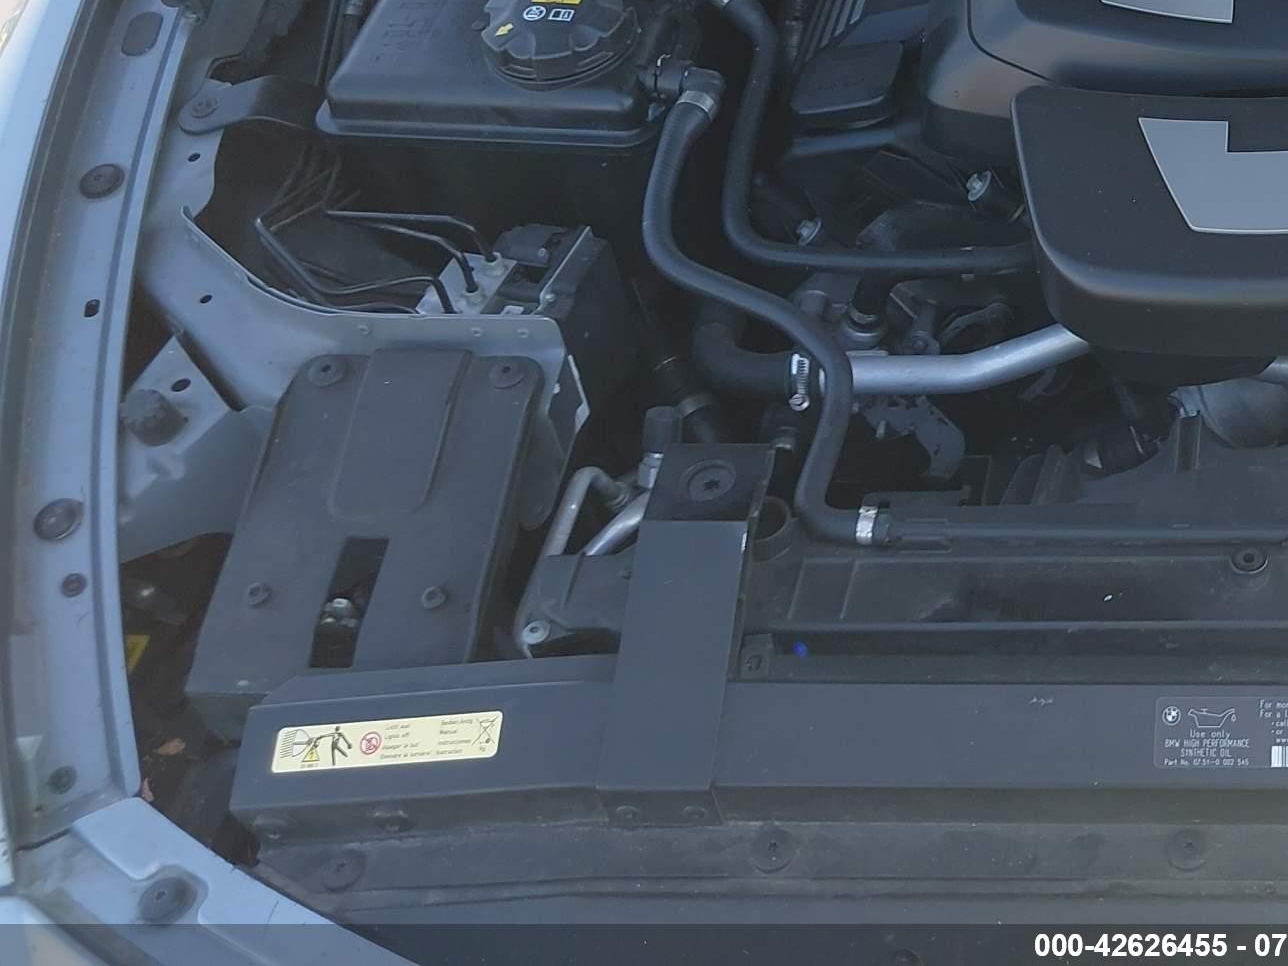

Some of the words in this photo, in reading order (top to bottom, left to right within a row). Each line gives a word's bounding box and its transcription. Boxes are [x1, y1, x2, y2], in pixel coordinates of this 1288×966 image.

[1259, 698, 1273, 709] For
[1259, 708, 1273, 718] For
[1190, 729, 1207, 738] Use
[1210, 729, 1232, 740] only
[1164, 738, 1181, 748] BMW
[1202, 738, 1251, 748] PERFORMANCE
[1180, 747, 1217, 758] SYNTHETIC
[1220, 747, 1233, 758] OIL
